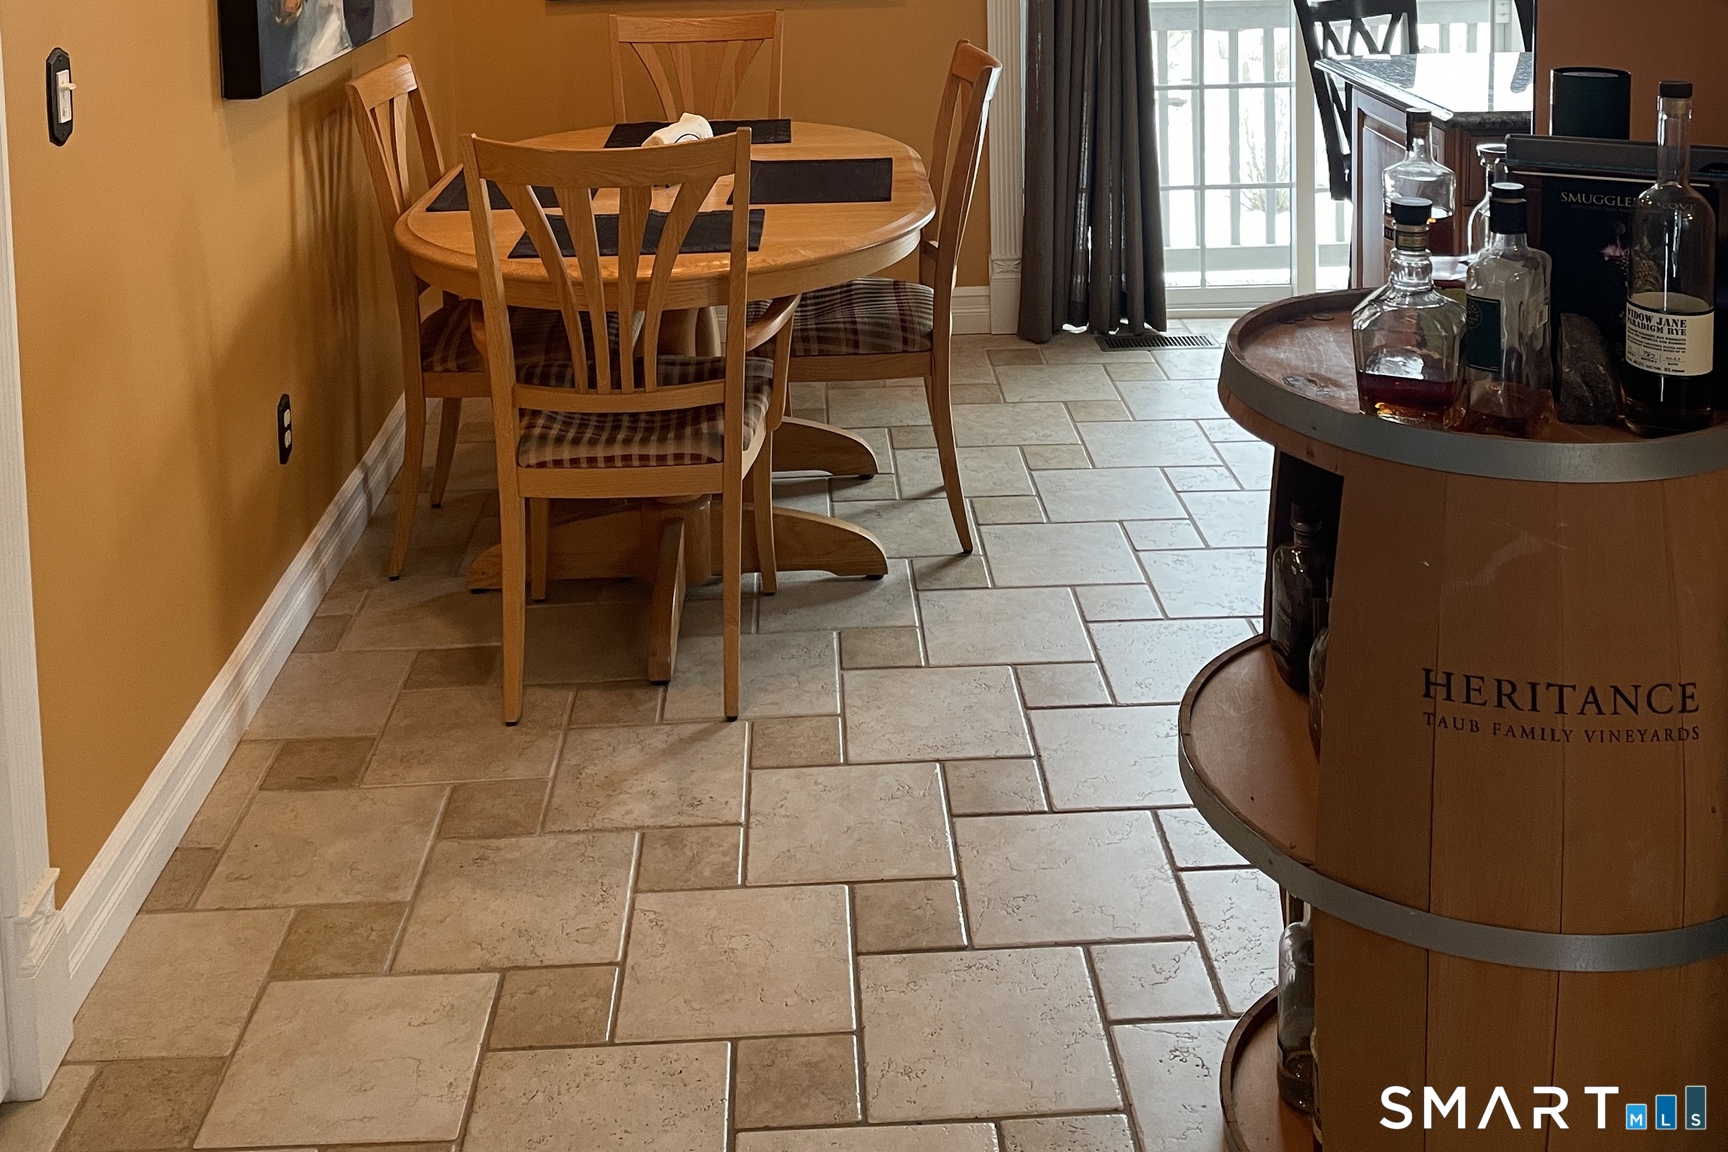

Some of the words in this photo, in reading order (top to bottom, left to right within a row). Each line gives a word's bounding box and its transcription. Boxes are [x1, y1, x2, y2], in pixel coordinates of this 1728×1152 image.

[1656, 317, 1687, 329] JANE
[1667, 327, 1687, 336] RYE
[1421, 667, 1700, 716] HERITANCE
[1423, 711, 1480, 733] TAUB
[1492, 722, 1573, 743] FAMILY
[1584, 725, 1700, 743] VINEYARDS
